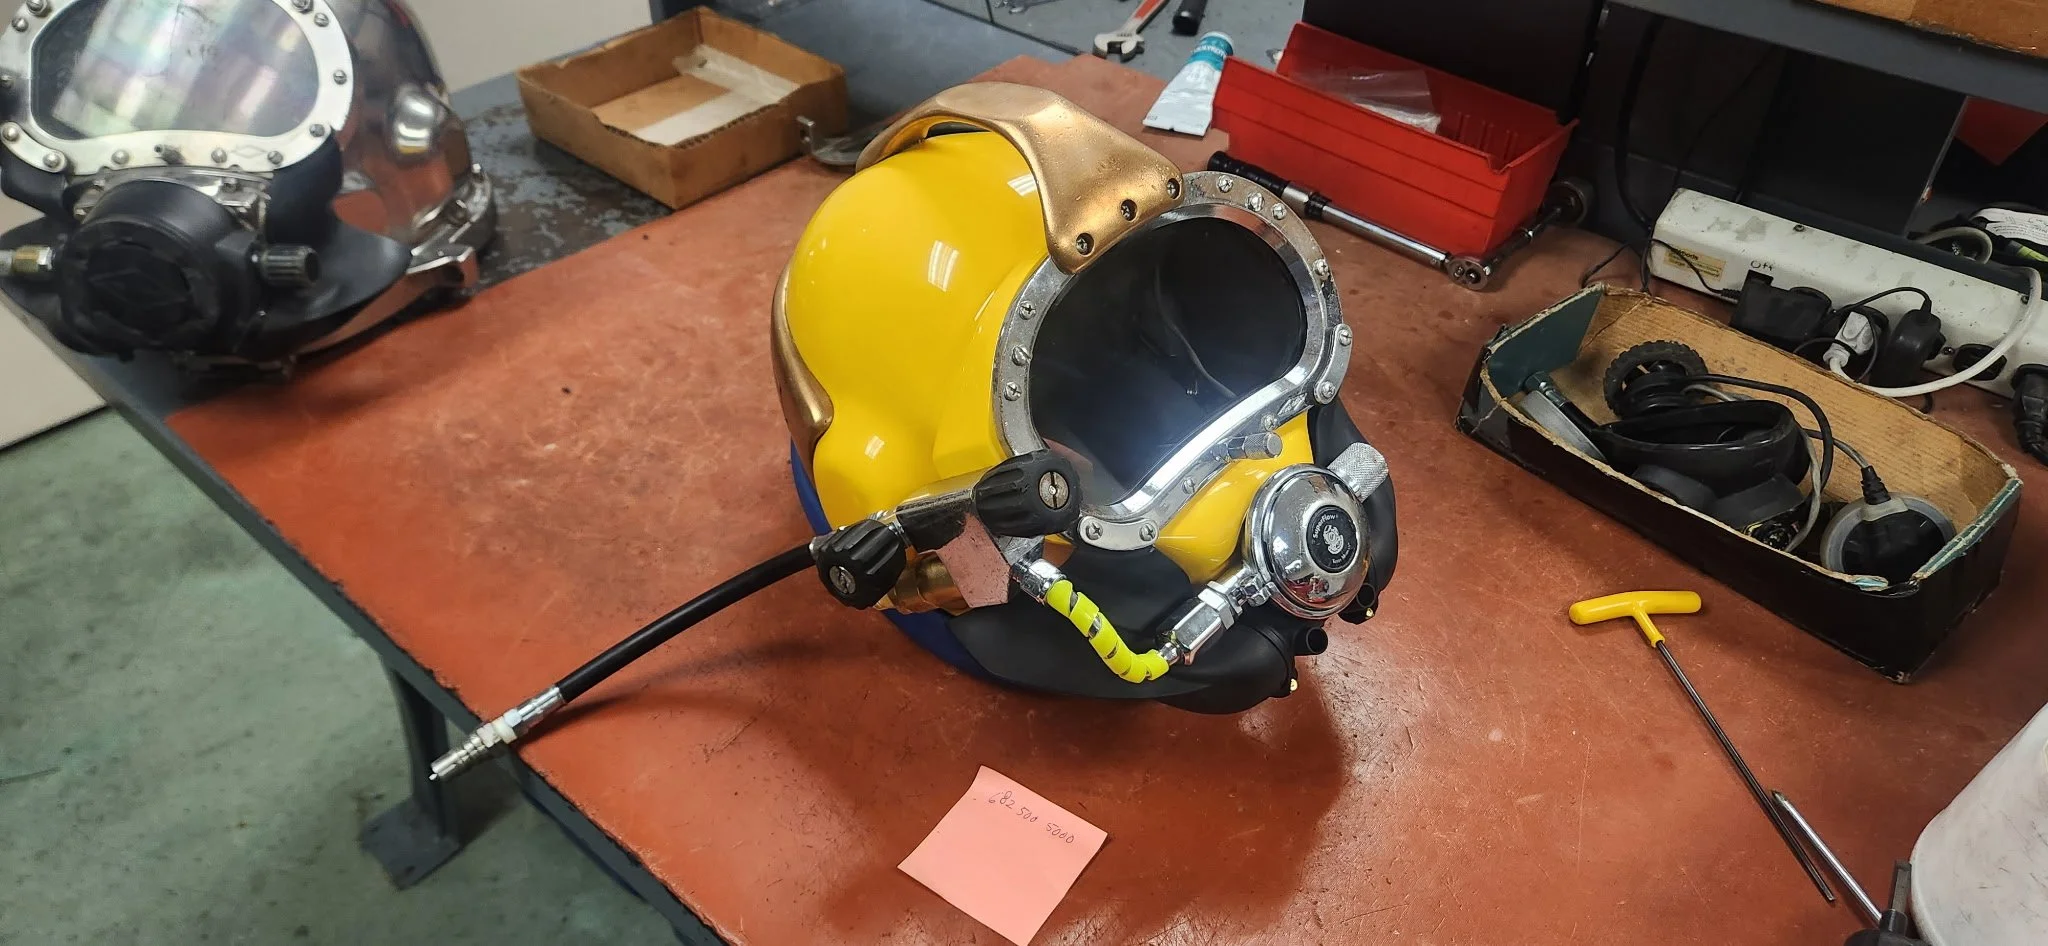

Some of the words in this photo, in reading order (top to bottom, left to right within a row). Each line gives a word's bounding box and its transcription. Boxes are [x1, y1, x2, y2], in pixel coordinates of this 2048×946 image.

[988, 790, 1015, 809] 682
[1016, 806, 1038, 823] 500
[1045, 822, 1075, 844] 5000
